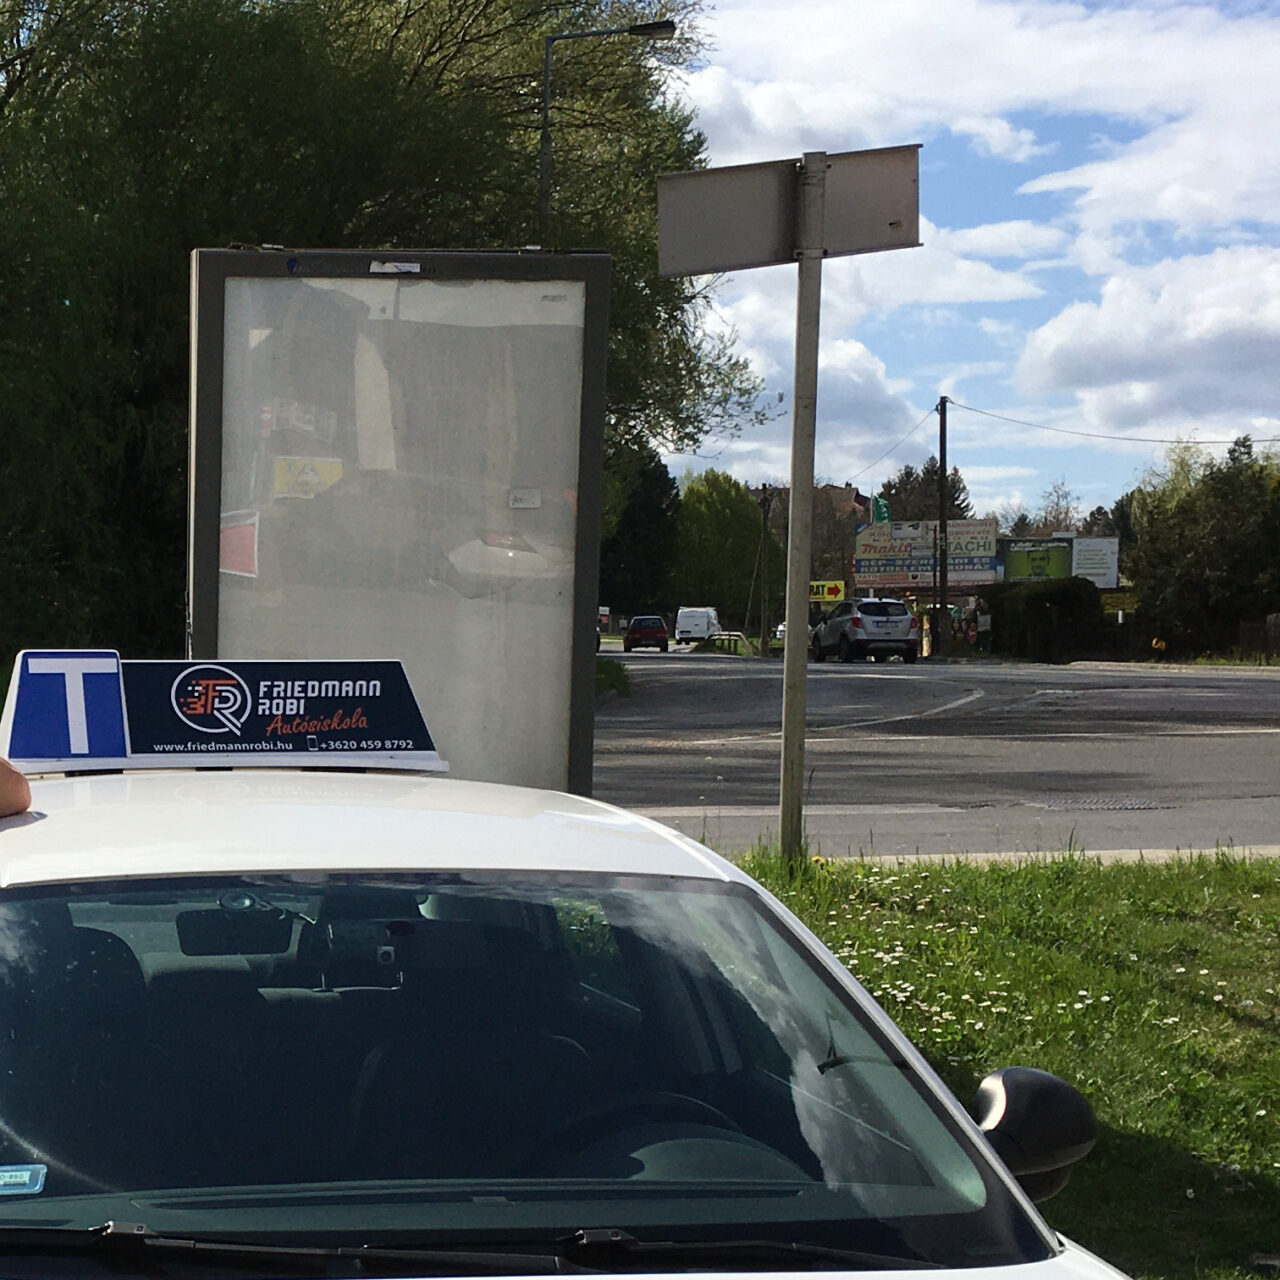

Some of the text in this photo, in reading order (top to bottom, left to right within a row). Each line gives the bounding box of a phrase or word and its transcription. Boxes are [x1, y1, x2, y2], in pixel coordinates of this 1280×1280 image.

[936, 540, 992, 552] TACHI
[258, 680, 381, 698] FRIEDMANN
[28, 658, 118, 755] T
[258, 699, 305, 715] ROBI
[266, 707, 368, 736] Autósiskola
[153, 739, 414, 751] www.friedmannrobi.hu +3620 459 8792
